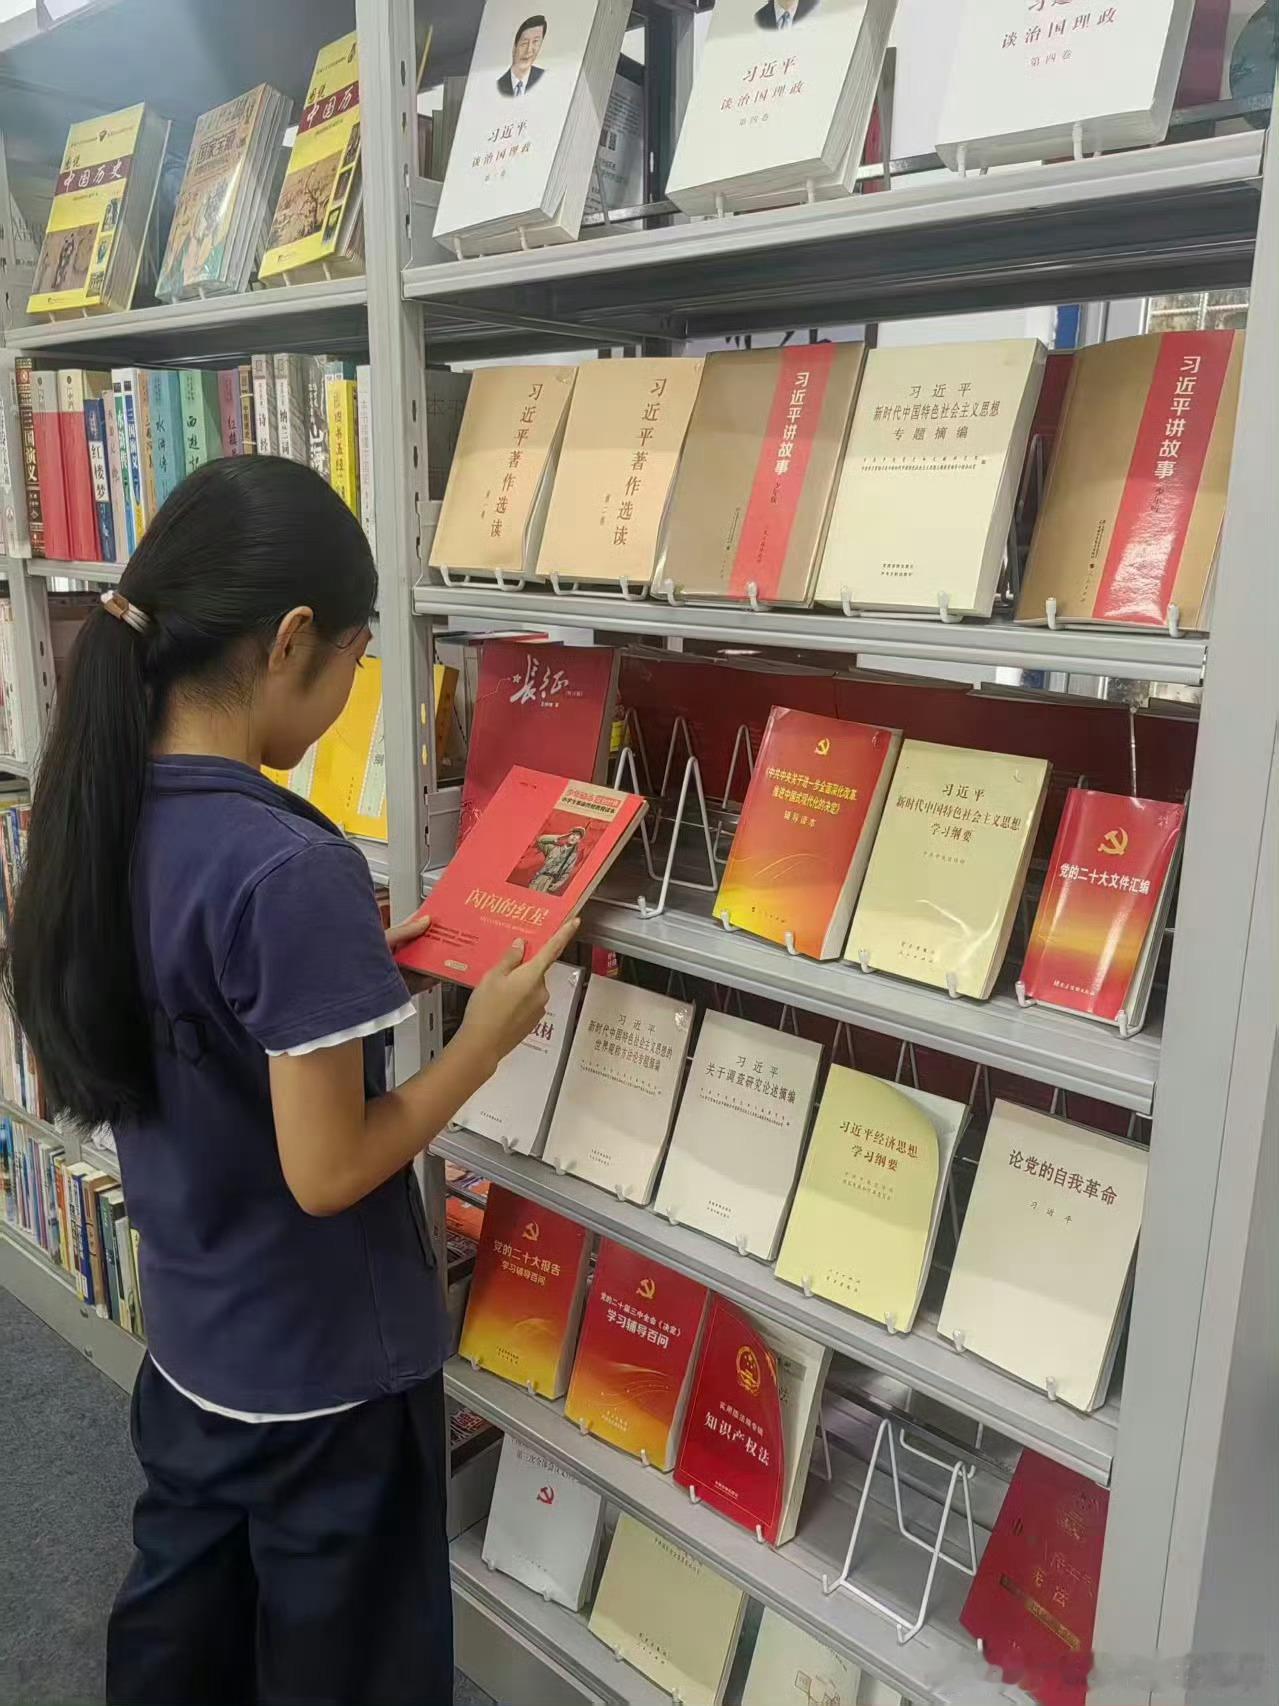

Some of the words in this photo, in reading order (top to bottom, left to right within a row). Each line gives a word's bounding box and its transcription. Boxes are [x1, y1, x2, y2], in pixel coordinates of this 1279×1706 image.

[1001, 7, 1117, 49] 谈治国理政
[742, 55, 798, 82] 习近平
[1031, 49, 1072, 67] 第四卷
[720, 80, 804, 111] 谈治国理政
[487, 119, 528, 143] 习近平
[908, 382, 973, 399] 习近平
[774, 371, 810, 477] 习近平讲故事
[873, 399, 1001, 421] 新时代中国特色社会主义思想
[1154, 356, 1202, 480] 习近平讲故事
[892, 425, 969, 441] 专题摘编
[91, 445, 106, 501] 红楼梦
[490, 383, 544, 538] 习近平著作选读
[612, 377, 668, 546] 习近平著作选读
[942, 783, 986, 802] 习近平
[896, 795, 1022, 831] 新时代中国特色社会主义思想
[930, 822, 974, 843] 学习纲要
[1059, 863, 1151, 895] 党的二十大文件汇编
[464, 887, 551, 926] 闪闪的红星
[618, 1014, 656, 1036] 习近平
[736, 1055, 779, 1078] 习近平
[705, 1062, 796, 1104] 关于调查研究论述摘编
[840, 1121, 920, 1159] 习近平经济思想
[851, 1144, 898, 1172] 学习纲要
[1008, 1149, 1118, 1206] 论党的自我革命
[1030, 1201, 1073, 1224] 习近平
[494, 1240, 561, 1277] 党的二十大报告
[502, 1260, 546, 1287] 学习辅导百问
[607, 1308, 669, 1349] 学习辅导百问
[704, 1411, 770, 1466] 知识产权法
